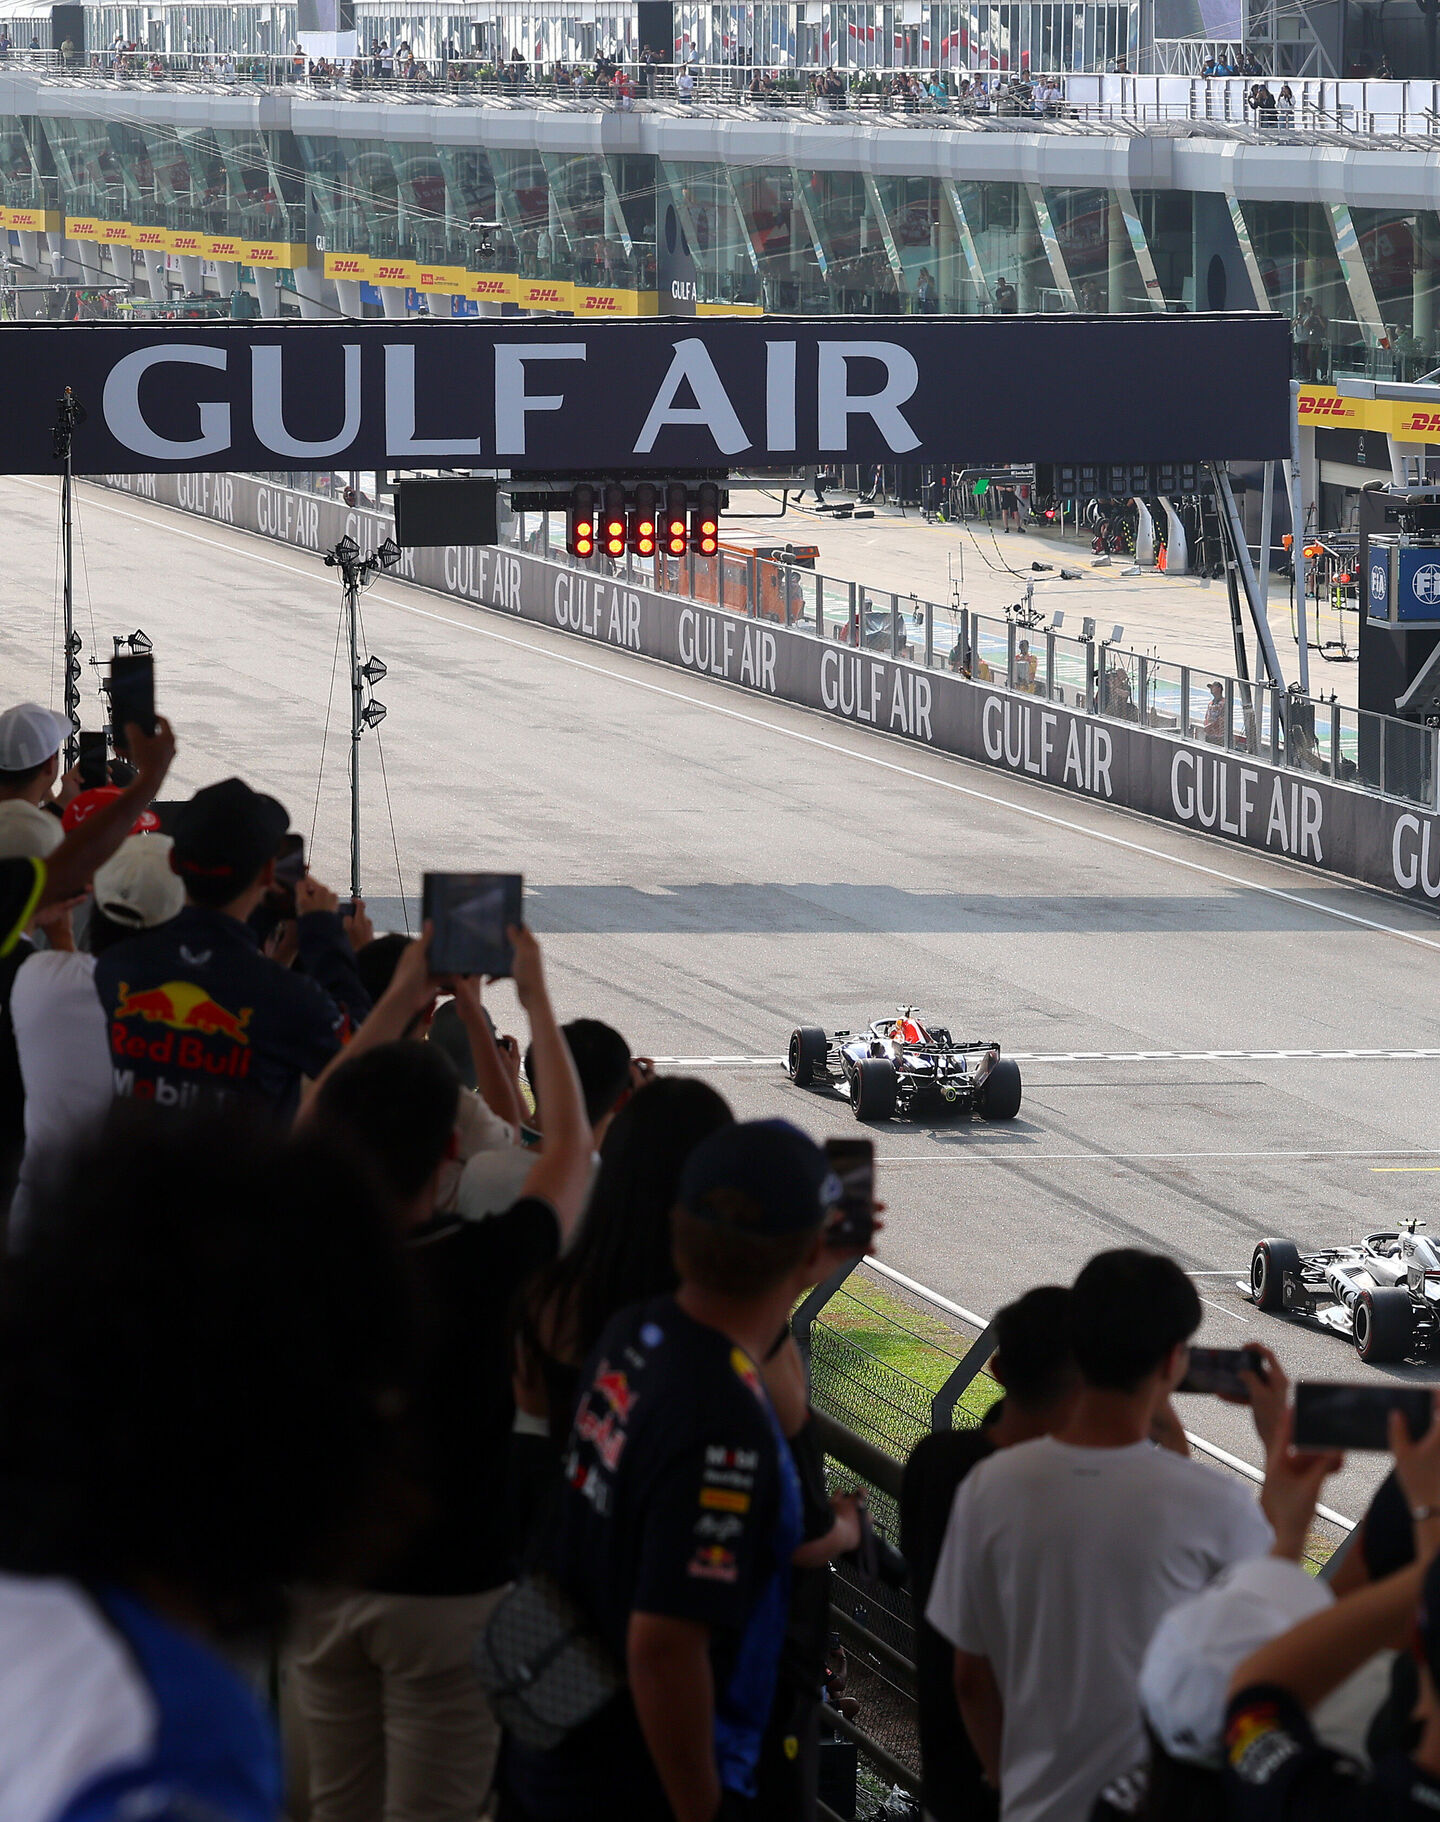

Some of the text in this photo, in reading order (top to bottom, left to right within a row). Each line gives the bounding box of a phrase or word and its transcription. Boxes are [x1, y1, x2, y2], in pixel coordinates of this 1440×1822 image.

[73, 223, 94, 234] DHL
[105, 228, 127, 238] DHL
[139, 233, 160, 244] DHL
[174, 238, 196, 249] DHL
[211, 243, 236, 254] DHL
[250, 248, 274, 260] DHL
[335, 260, 360, 273] DHL
[379, 267, 405, 279] DHL
[477, 281, 505, 294] DHL
[529, 288, 560, 302] DHL
[671, 279, 691, 301] GULF
[585, 296, 616, 310] DHL
[102, 338, 924, 460] GULF AIR
[1298, 396, 1346, 416] DHL
[177, 473, 234, 523] GULF AIR
[257, 487, 319, 549] GULF AIR
[444, 546, 521, 613] GULF AIR
[554, 572, 641, 650] GULF AIR
[678, 608, 777, 693] GULF AIR
[820, 649, 932, 741] GULF AIR
[982, 696, 1113, 798] GULF AIR
[1171, 750, 1323, 863] GULF AIR
[111, 1021, 253, 1079] Red Bull
